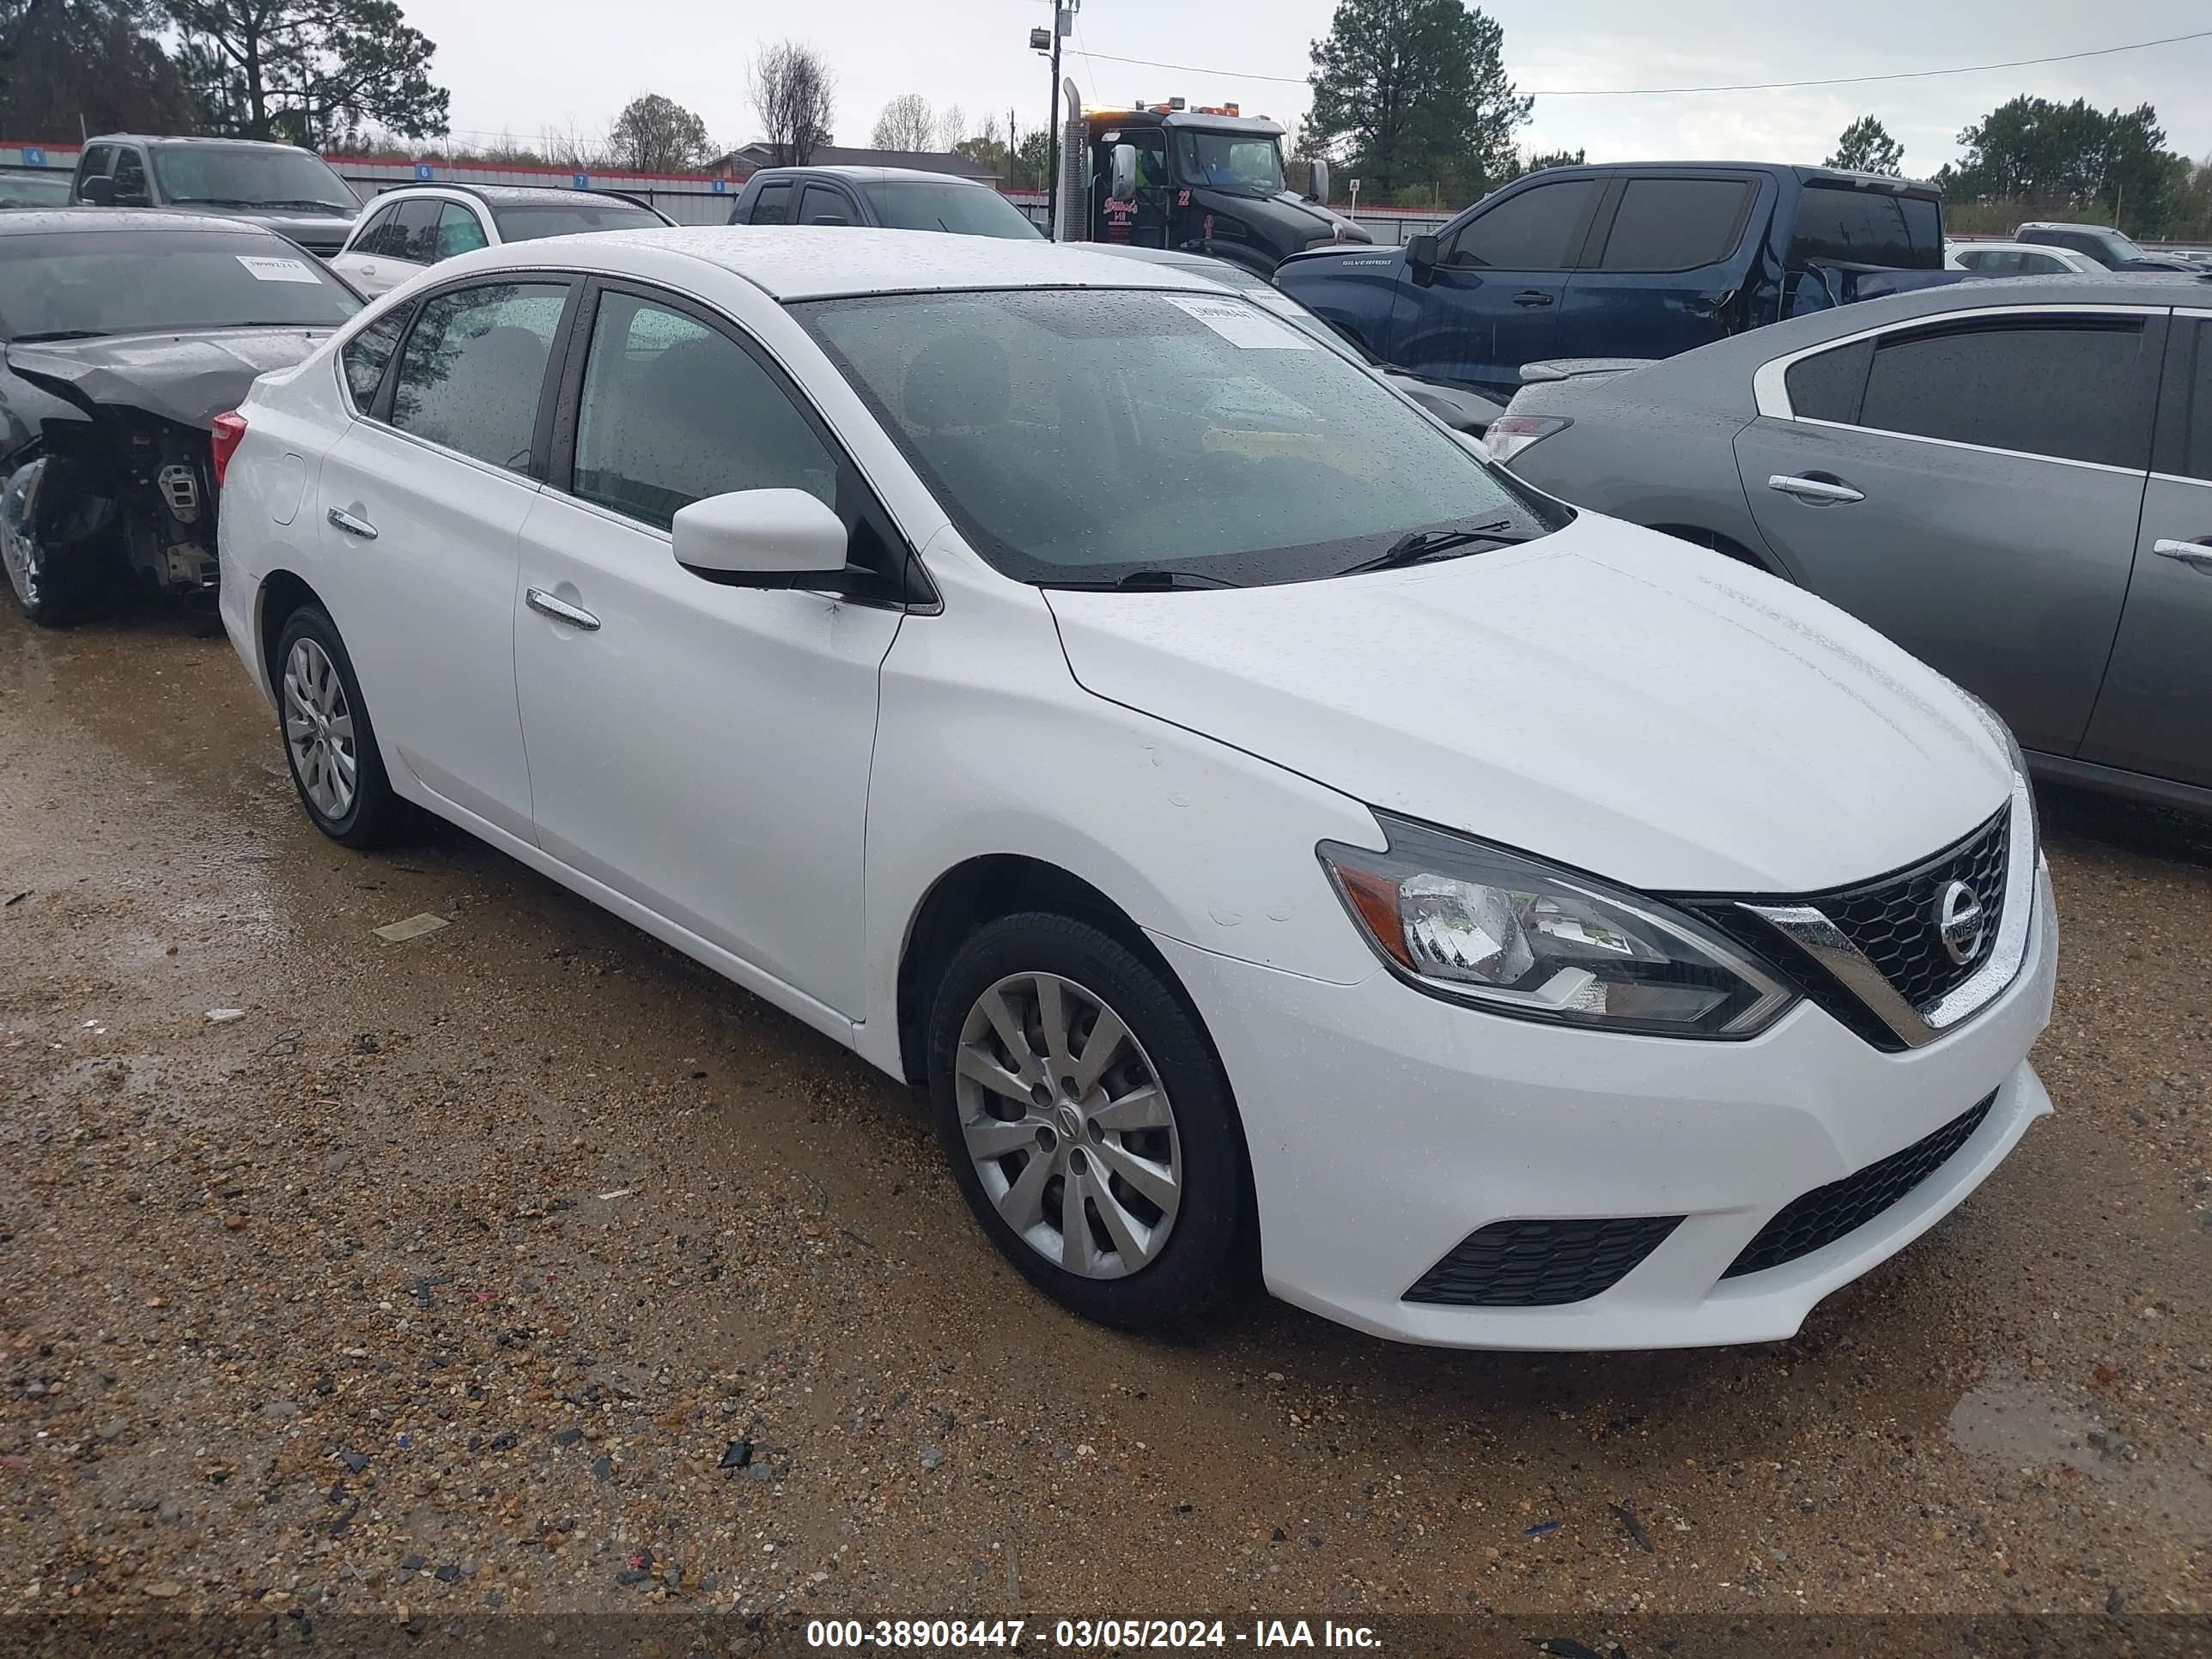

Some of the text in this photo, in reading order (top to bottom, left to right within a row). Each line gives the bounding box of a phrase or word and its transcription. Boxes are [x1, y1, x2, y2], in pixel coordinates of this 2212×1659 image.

[31, 150, 40, 163] 4
[421, 167, 428, 177] 6
[578, 176, 584, 186] 7
[1178, 190, 1190, 206] 22
[1949, 913, 1982, 939] NISS
